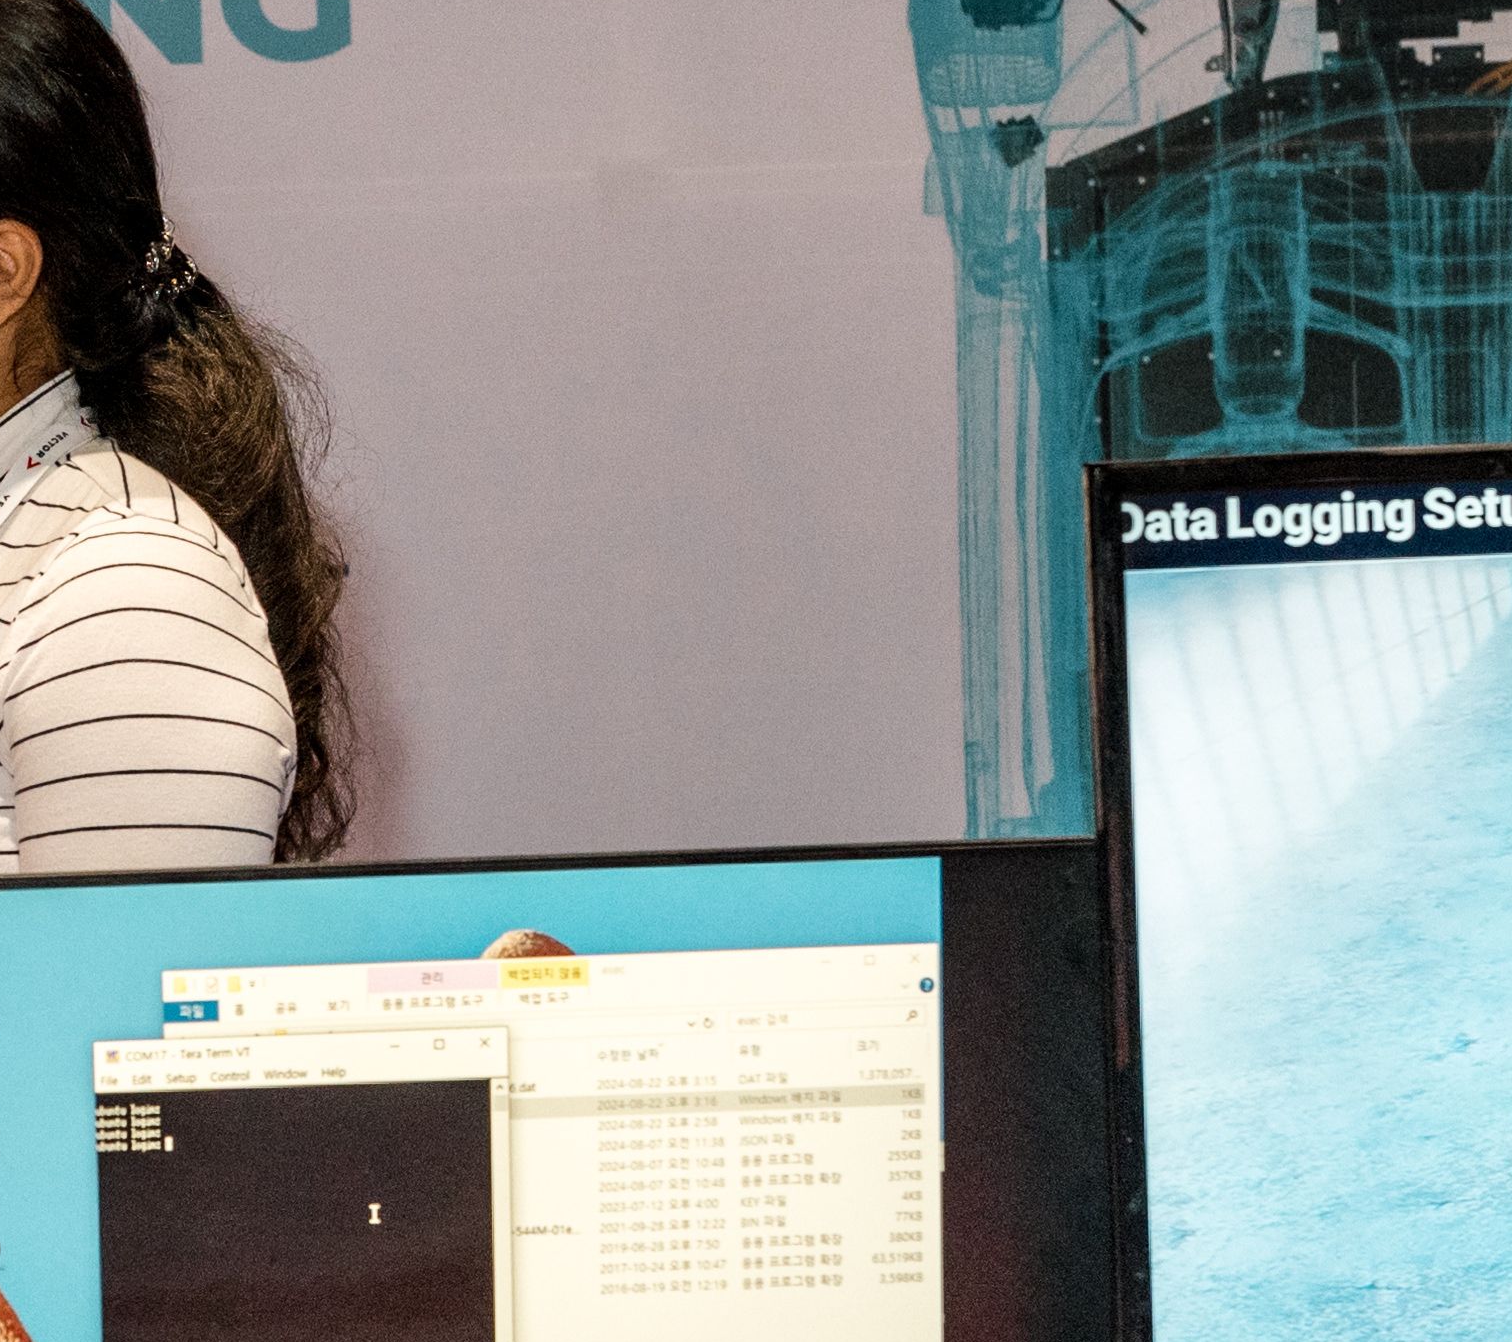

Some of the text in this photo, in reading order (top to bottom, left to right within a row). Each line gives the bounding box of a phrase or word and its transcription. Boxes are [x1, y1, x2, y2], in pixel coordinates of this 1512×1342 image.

[35, 431, 70, 459] VECTOR
[1121, 500, 1218, 545] Data
[1225, 490, 1415, 547] Logging
[181, 1050, 202, 1060] Tera
[206, 1049, 232, 1059] Term
[237, 1048, 250, 1057] VT
[132, 1075, 152, 1085] Edit
[166, 1073, 197, 1085] Setup
[210, 1071, 250, 1082] Control
[264, 1069, 307, 1080] Window
[321, 1067, 346, 1079] Help
